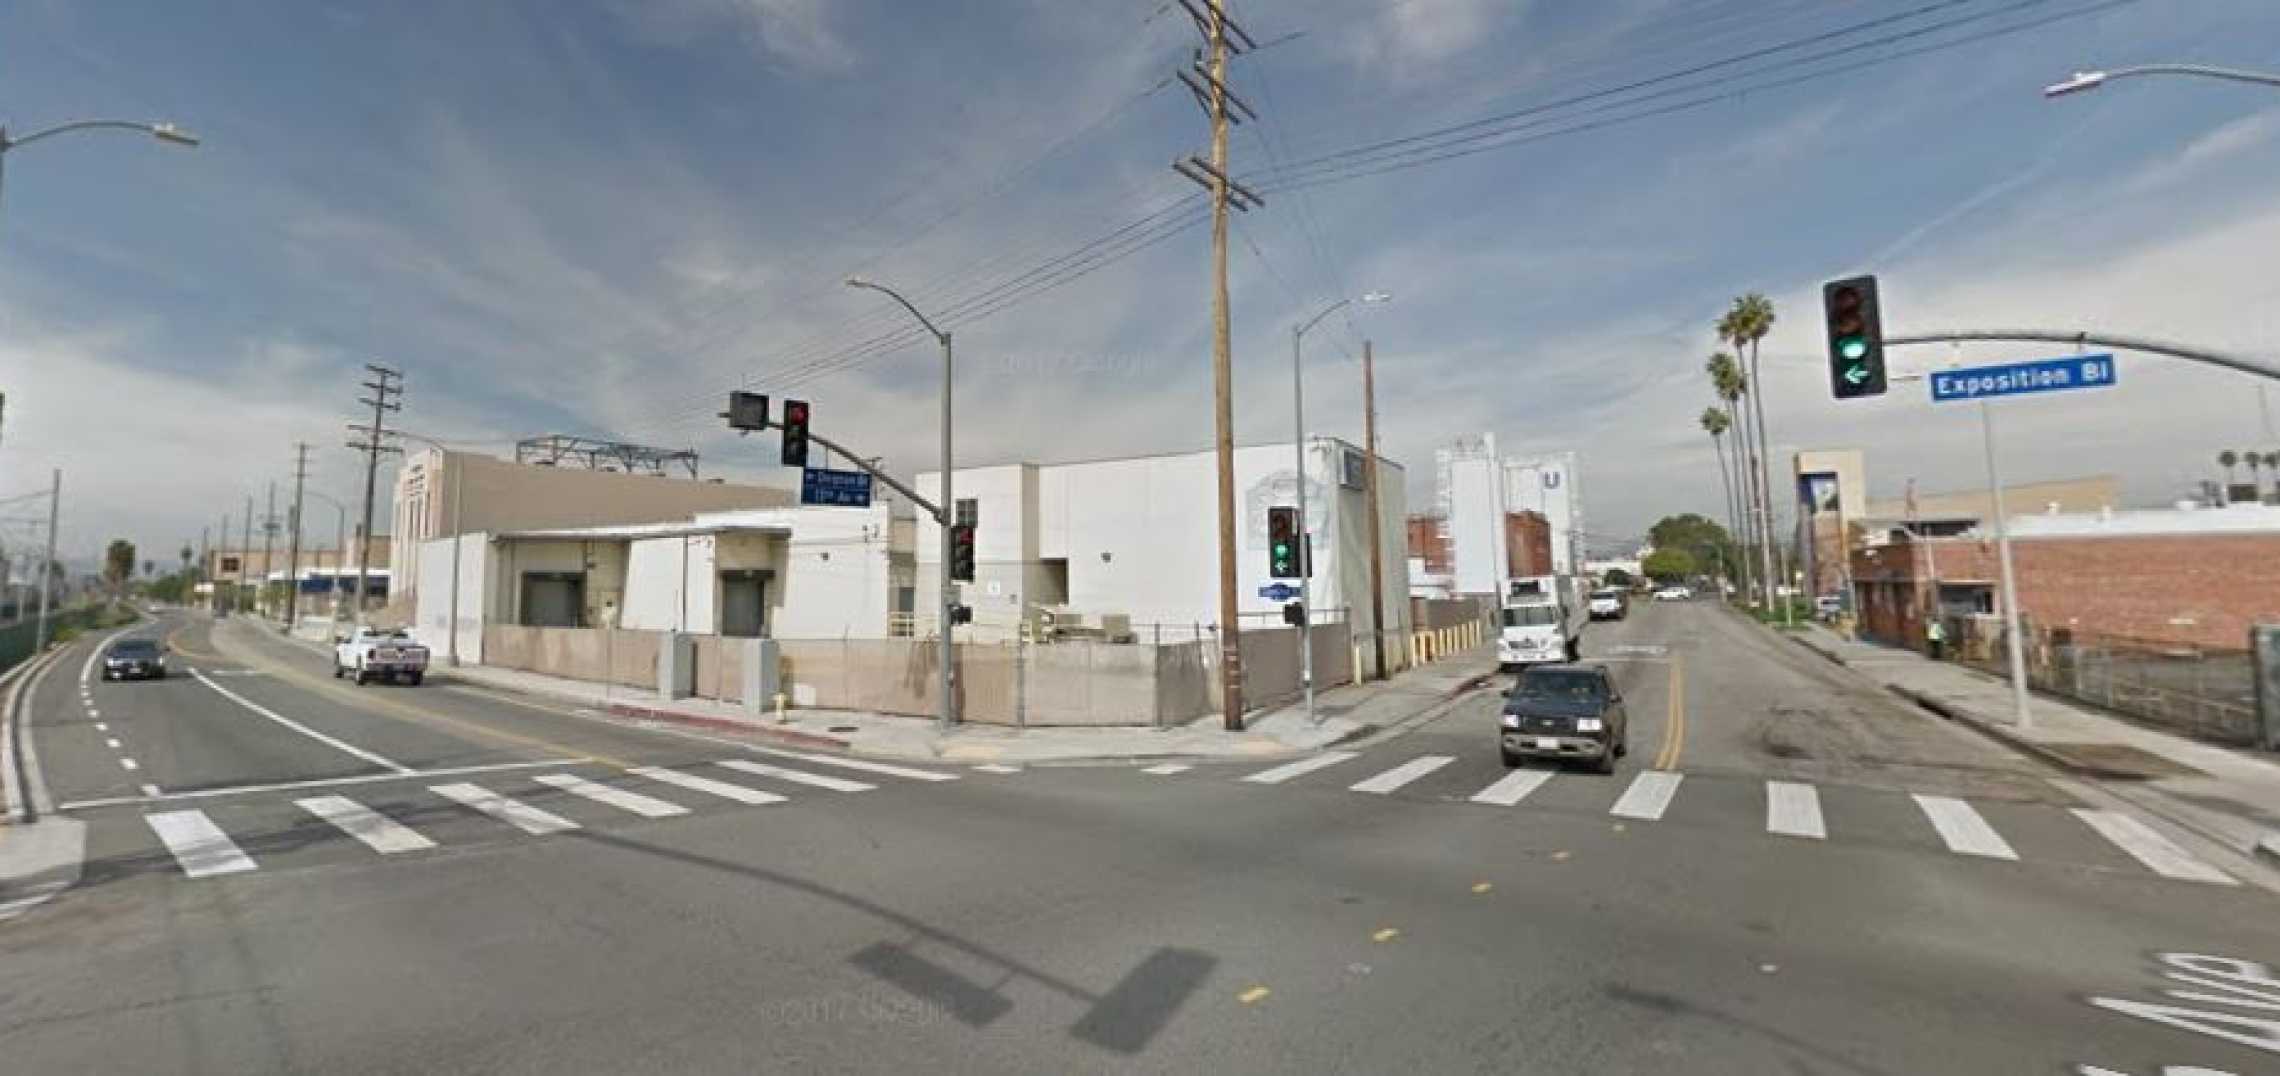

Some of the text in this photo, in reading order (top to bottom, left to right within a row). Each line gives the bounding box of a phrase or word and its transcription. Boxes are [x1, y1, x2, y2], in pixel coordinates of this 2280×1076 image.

[1936, 360, 2110, 398] Exposition Bl
[1544, 471, 1561, 489] U
